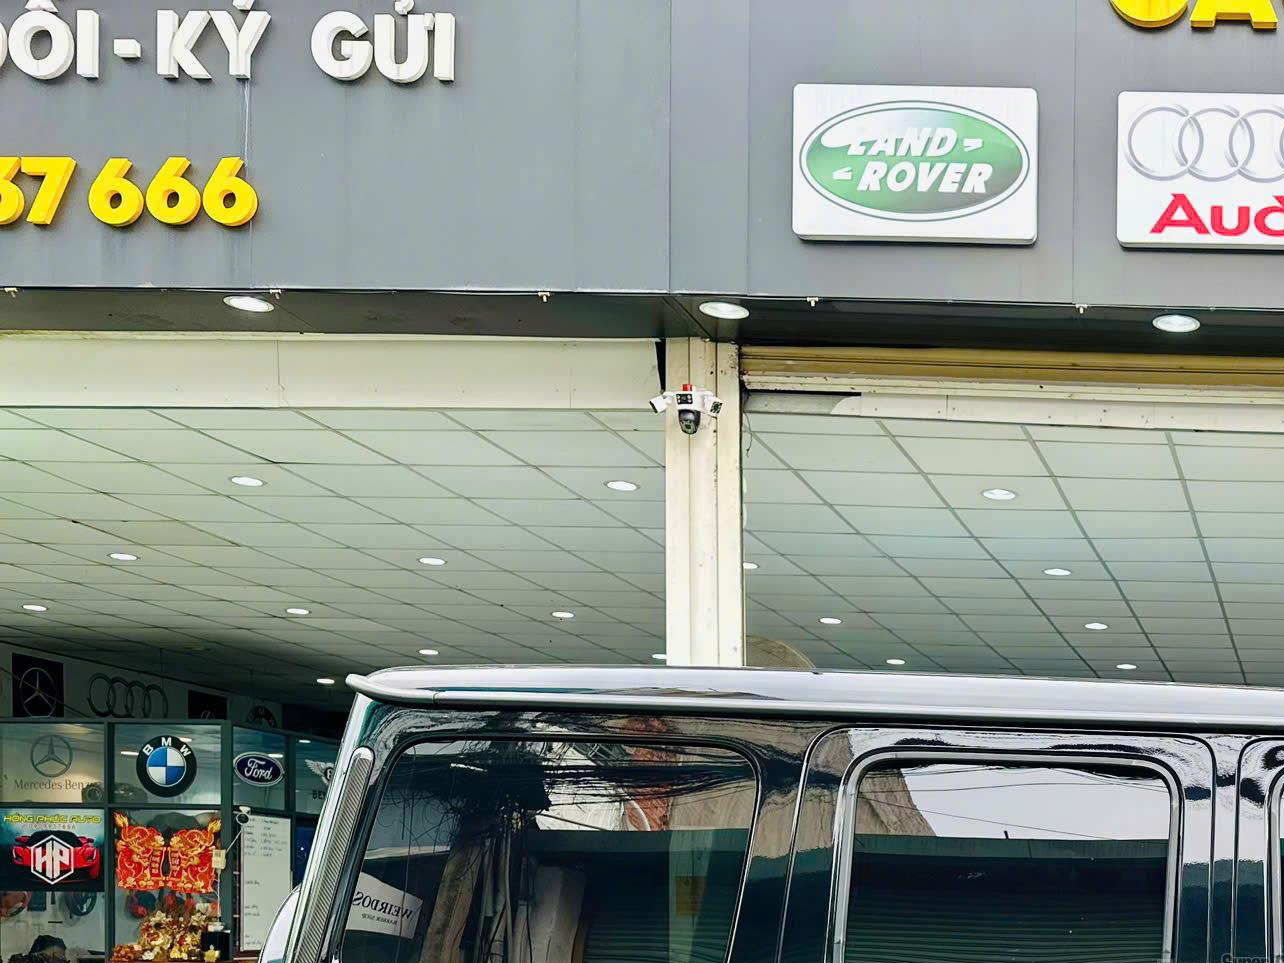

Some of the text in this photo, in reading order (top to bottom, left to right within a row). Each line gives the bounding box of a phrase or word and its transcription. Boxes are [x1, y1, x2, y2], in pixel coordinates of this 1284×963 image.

[311, 0, 456, 84] GỬI
[847, 127, 958, 157] LAND
[88, 156, 258, 227] 666
[856, 160, 993, 193] ROVER
[141, 736, 192, 757] BMW
[244, 758, 273, 780] Ford
